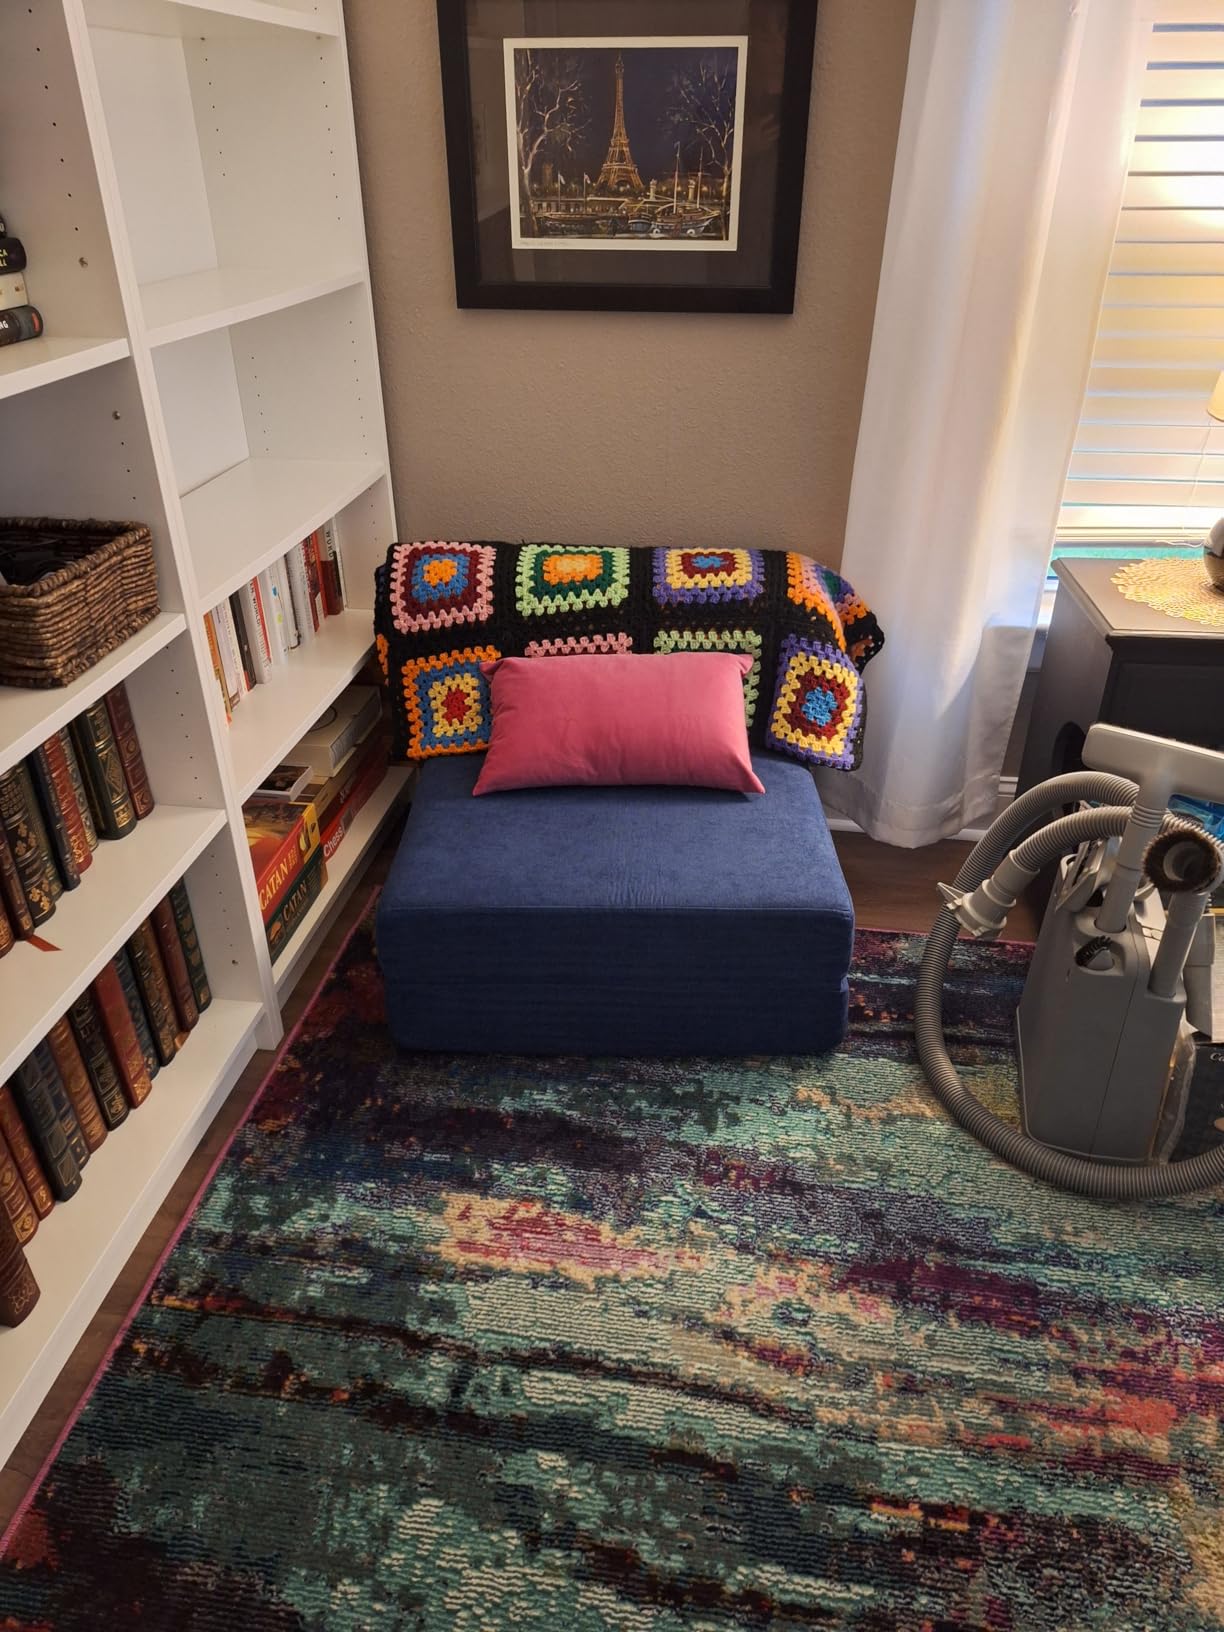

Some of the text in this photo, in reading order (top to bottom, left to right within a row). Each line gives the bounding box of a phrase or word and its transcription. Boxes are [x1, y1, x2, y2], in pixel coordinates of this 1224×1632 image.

[323, 827, 344, 857] Chess
[259, 858, 289, 911] CATAN
[283, 880, 308, 921] CATAN
